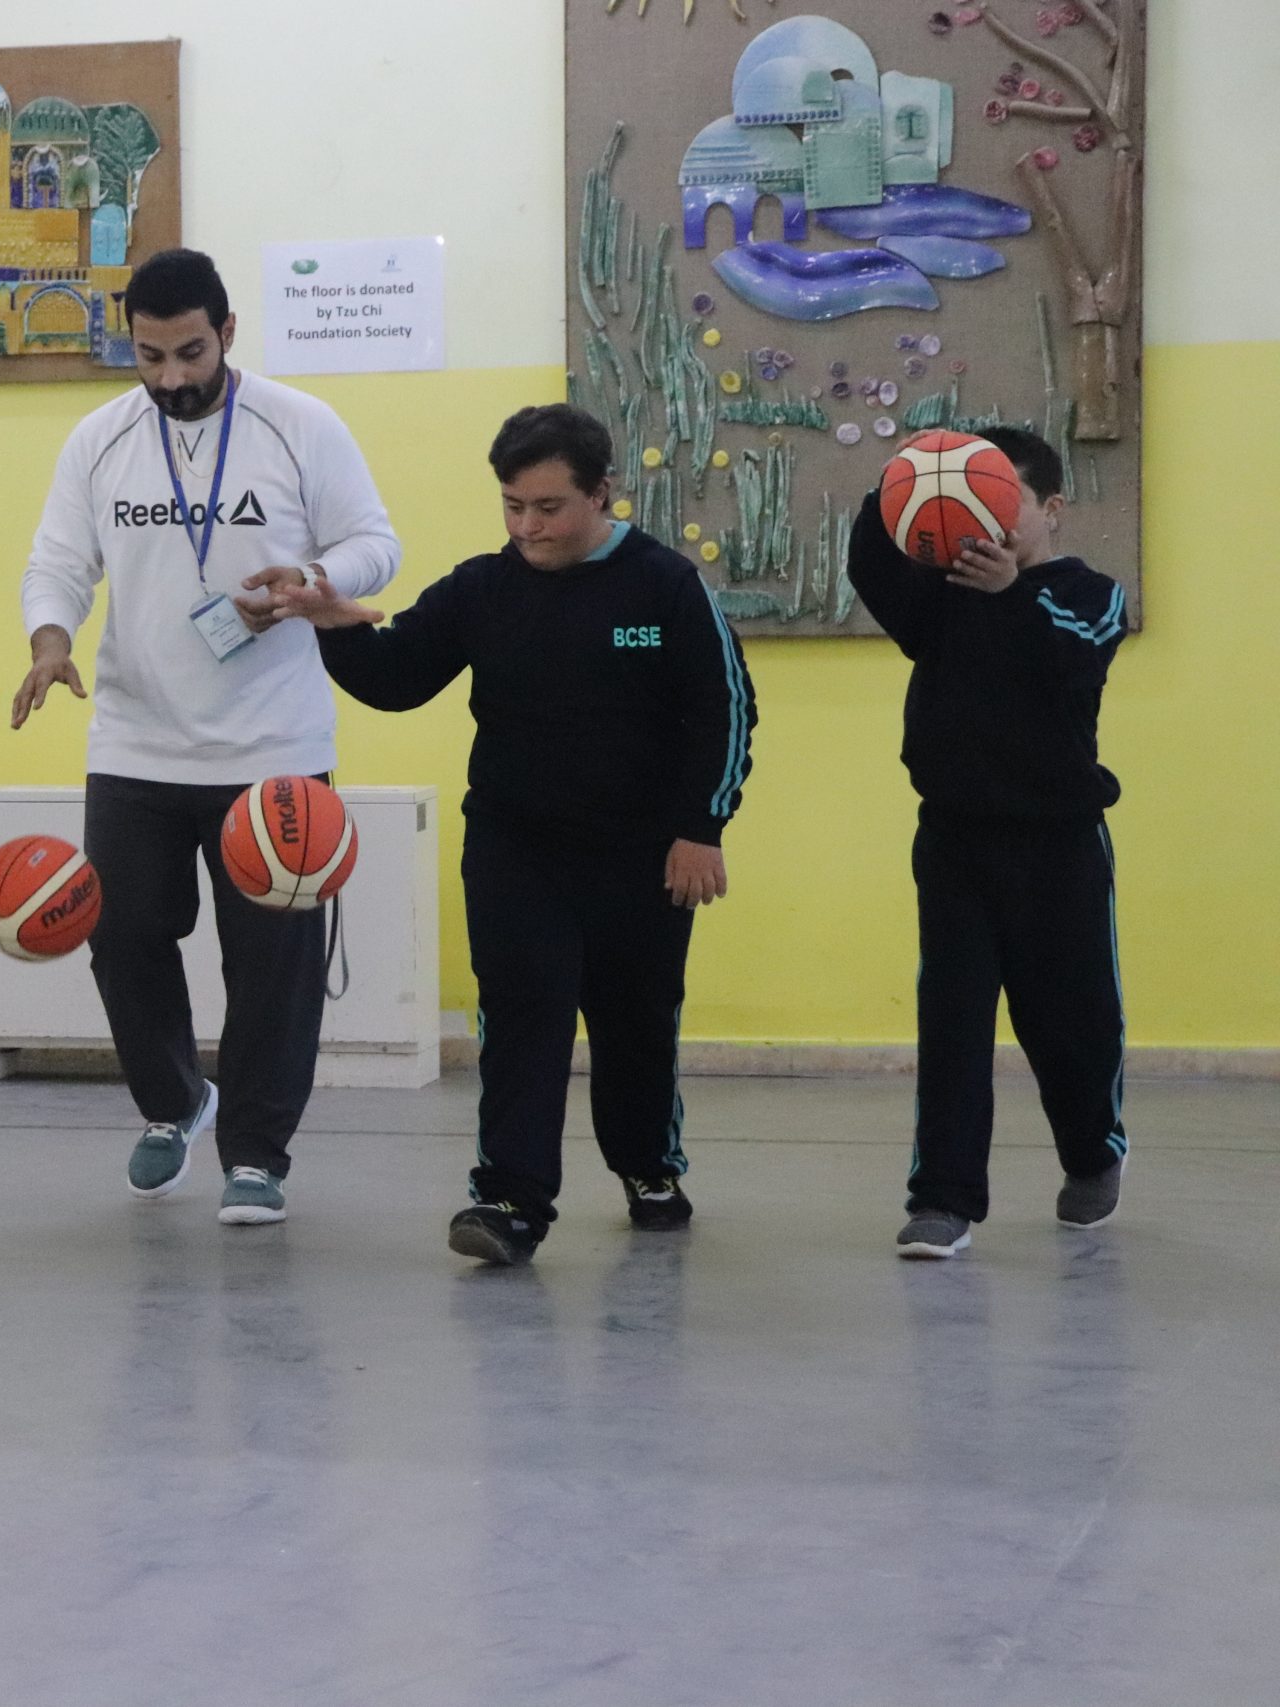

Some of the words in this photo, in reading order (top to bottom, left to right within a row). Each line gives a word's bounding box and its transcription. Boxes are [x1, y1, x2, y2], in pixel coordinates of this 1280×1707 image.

[284, 287, 307, 298] The
[311, 285, 342, 297] floor
[346, 284, 356, 296] is
[360, 282, 414, 295] donated
[316, 307, 332, 320] by
[336, 306, 358, 317] Tzu
[362, 304, 382, 316] Chi
[288, 326, 361, 340] Foundation
[365, 325, 412, 338] Society
[613, 626, 661, 648] BCSE
